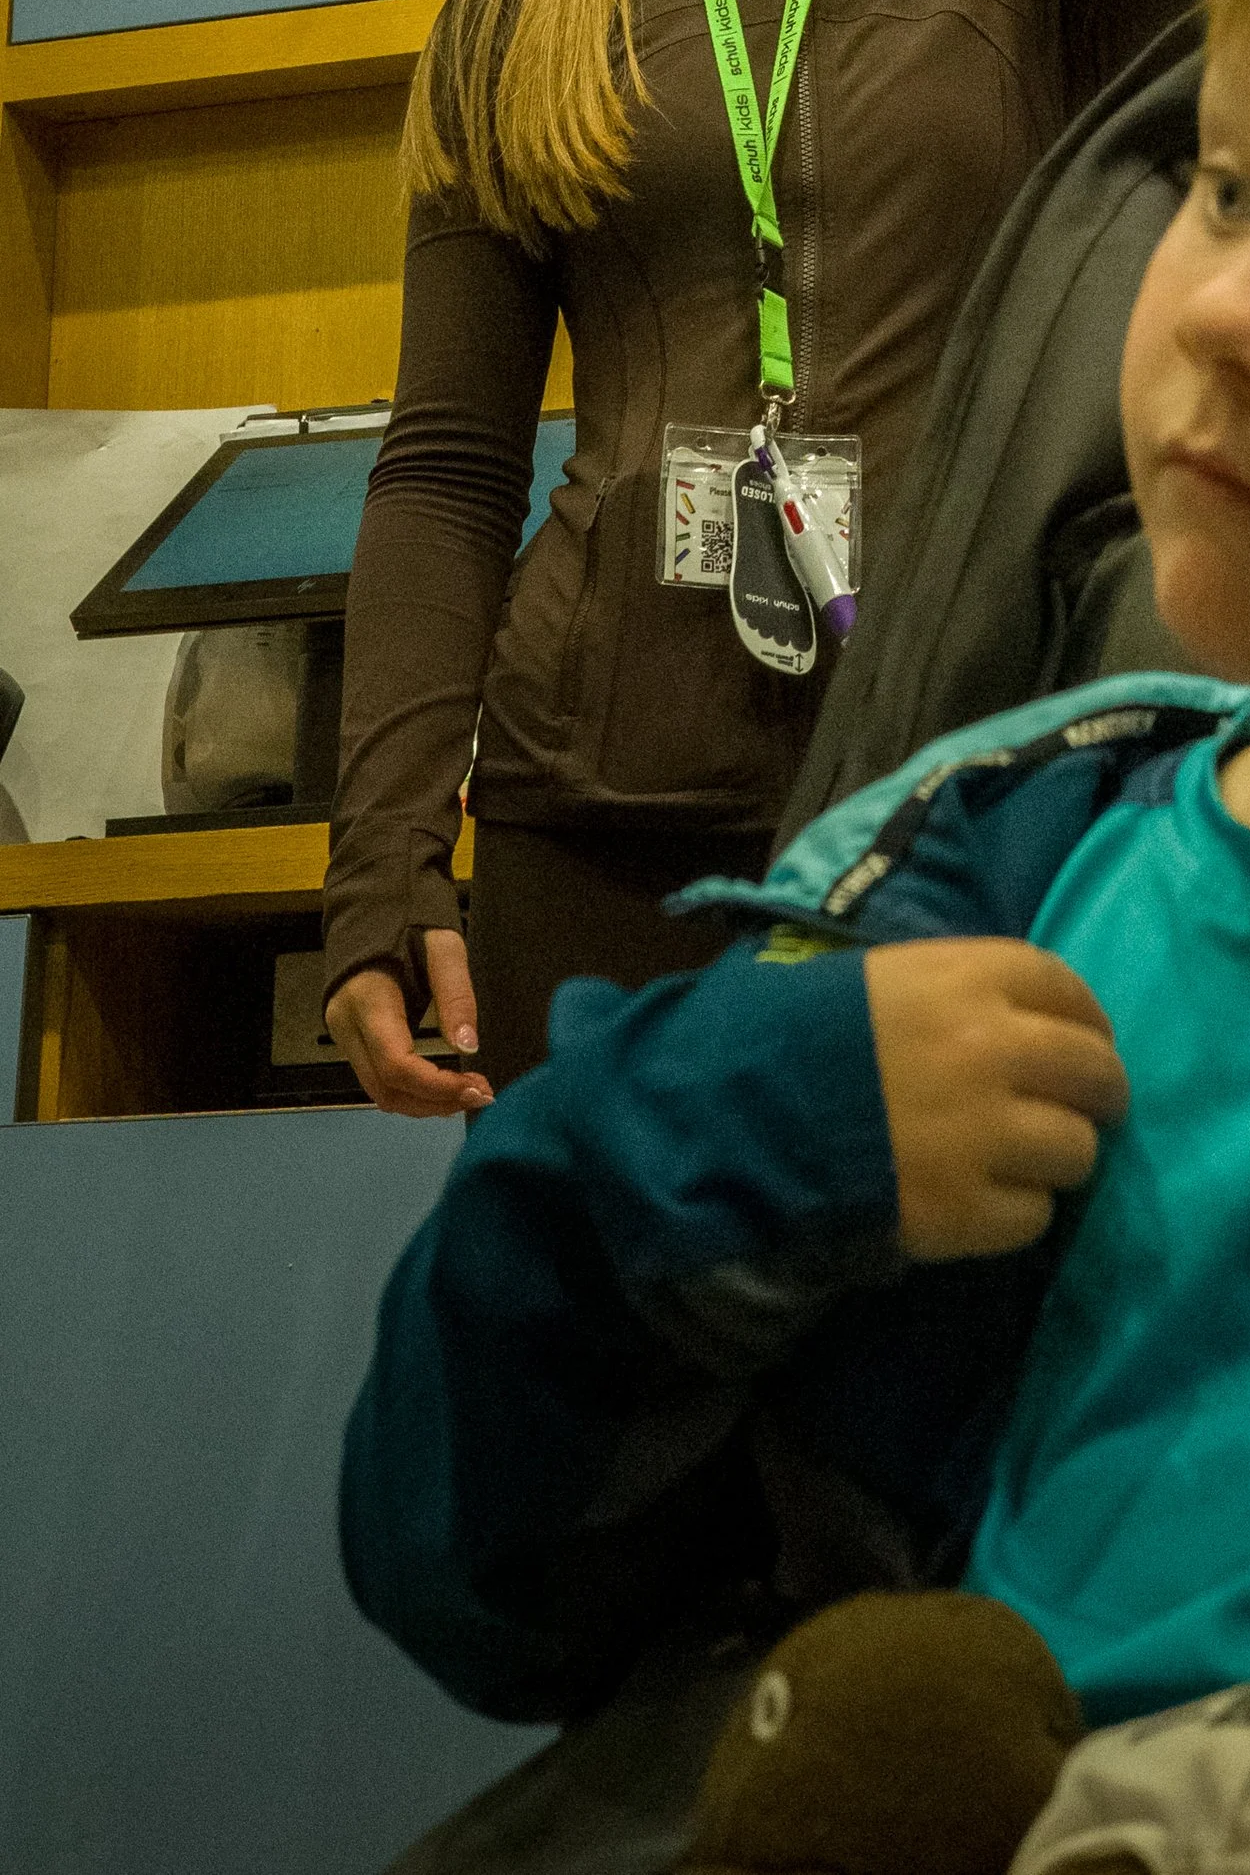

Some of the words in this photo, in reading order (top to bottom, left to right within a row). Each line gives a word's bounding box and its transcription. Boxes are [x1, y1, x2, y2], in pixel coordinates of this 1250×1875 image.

[725, 36, 742, 76] schuh
[776, 39, 795, 78] kids
[735, 93, 753, 131] kids
[745, 138, 763, 184] schuh
[741, 485, 776, 504] LOSED
[745, 593, 768, 606] kids
